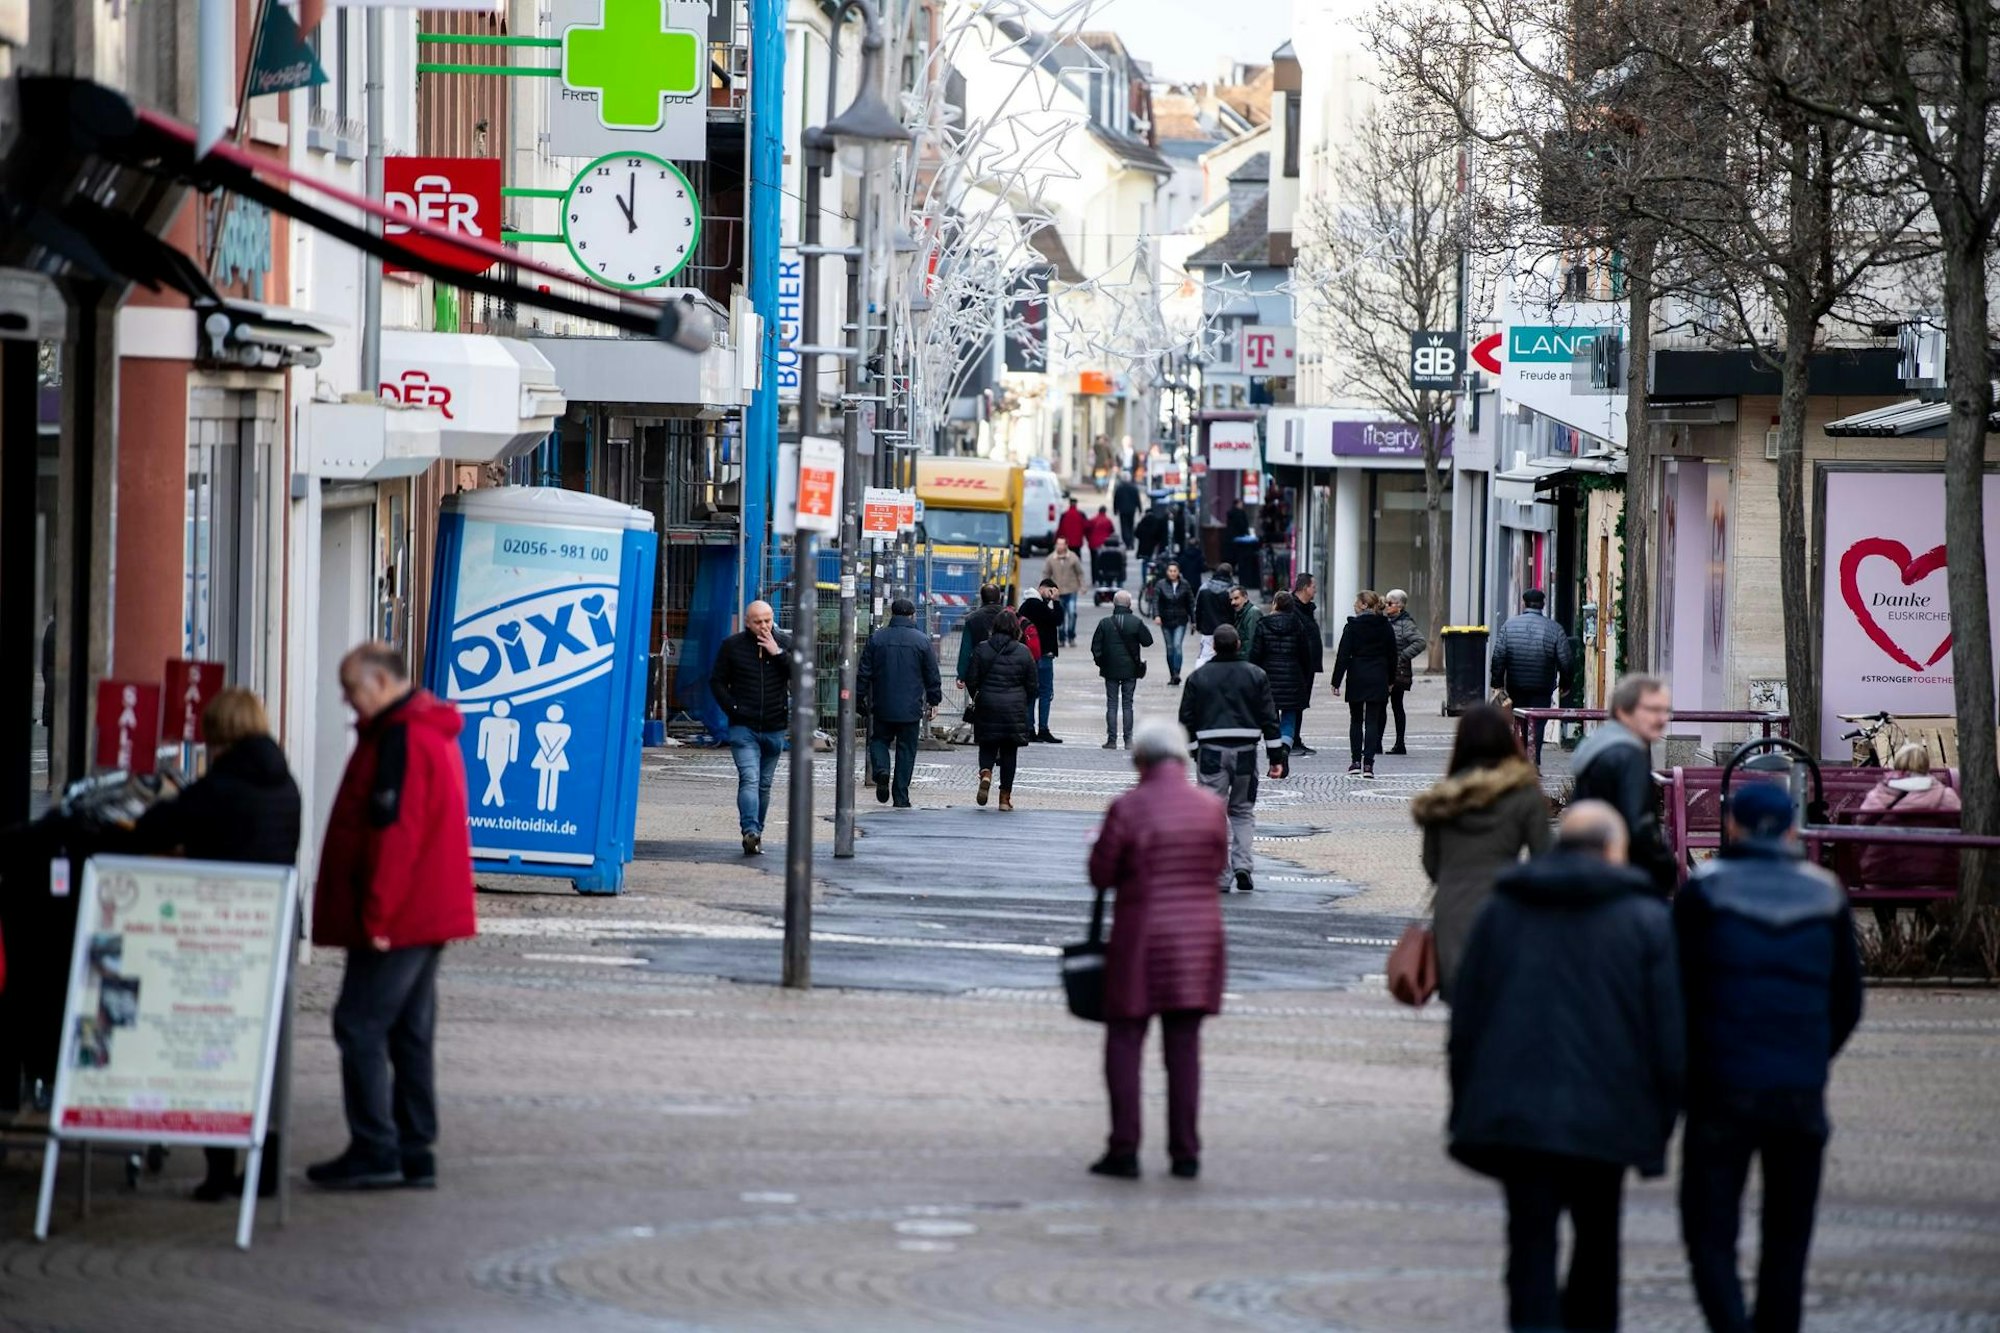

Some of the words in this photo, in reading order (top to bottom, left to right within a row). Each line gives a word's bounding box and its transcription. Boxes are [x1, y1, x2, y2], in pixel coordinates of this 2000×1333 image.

[628, 159, 641, 167] 12
[597, 168, 610, 176] 11
[660, 171, 665, 179] 1
[677, 190, 684, 198] 2
[571, 214, 578, 223] 9
[685, 217, 692, 226] 3
[579, 241, 586, 249] 8
[677, 245, 684, 253] 4
[600, 263, 606, 272] 7
[655, 266, 661, 274] 5
[628, 273, 635, 281] 6
[1520, 370, 1556, 380] Freude
[934, 478, 989, 490] DHL
[503, 538, 548, 556] 02056
[560, 544, 585, 559] 981
[591, 547, 609, 562] 00
[1872, 592, 1931, 607] Danke
[1861, 676, 1954, 684] #STRONGERTOGETHE
